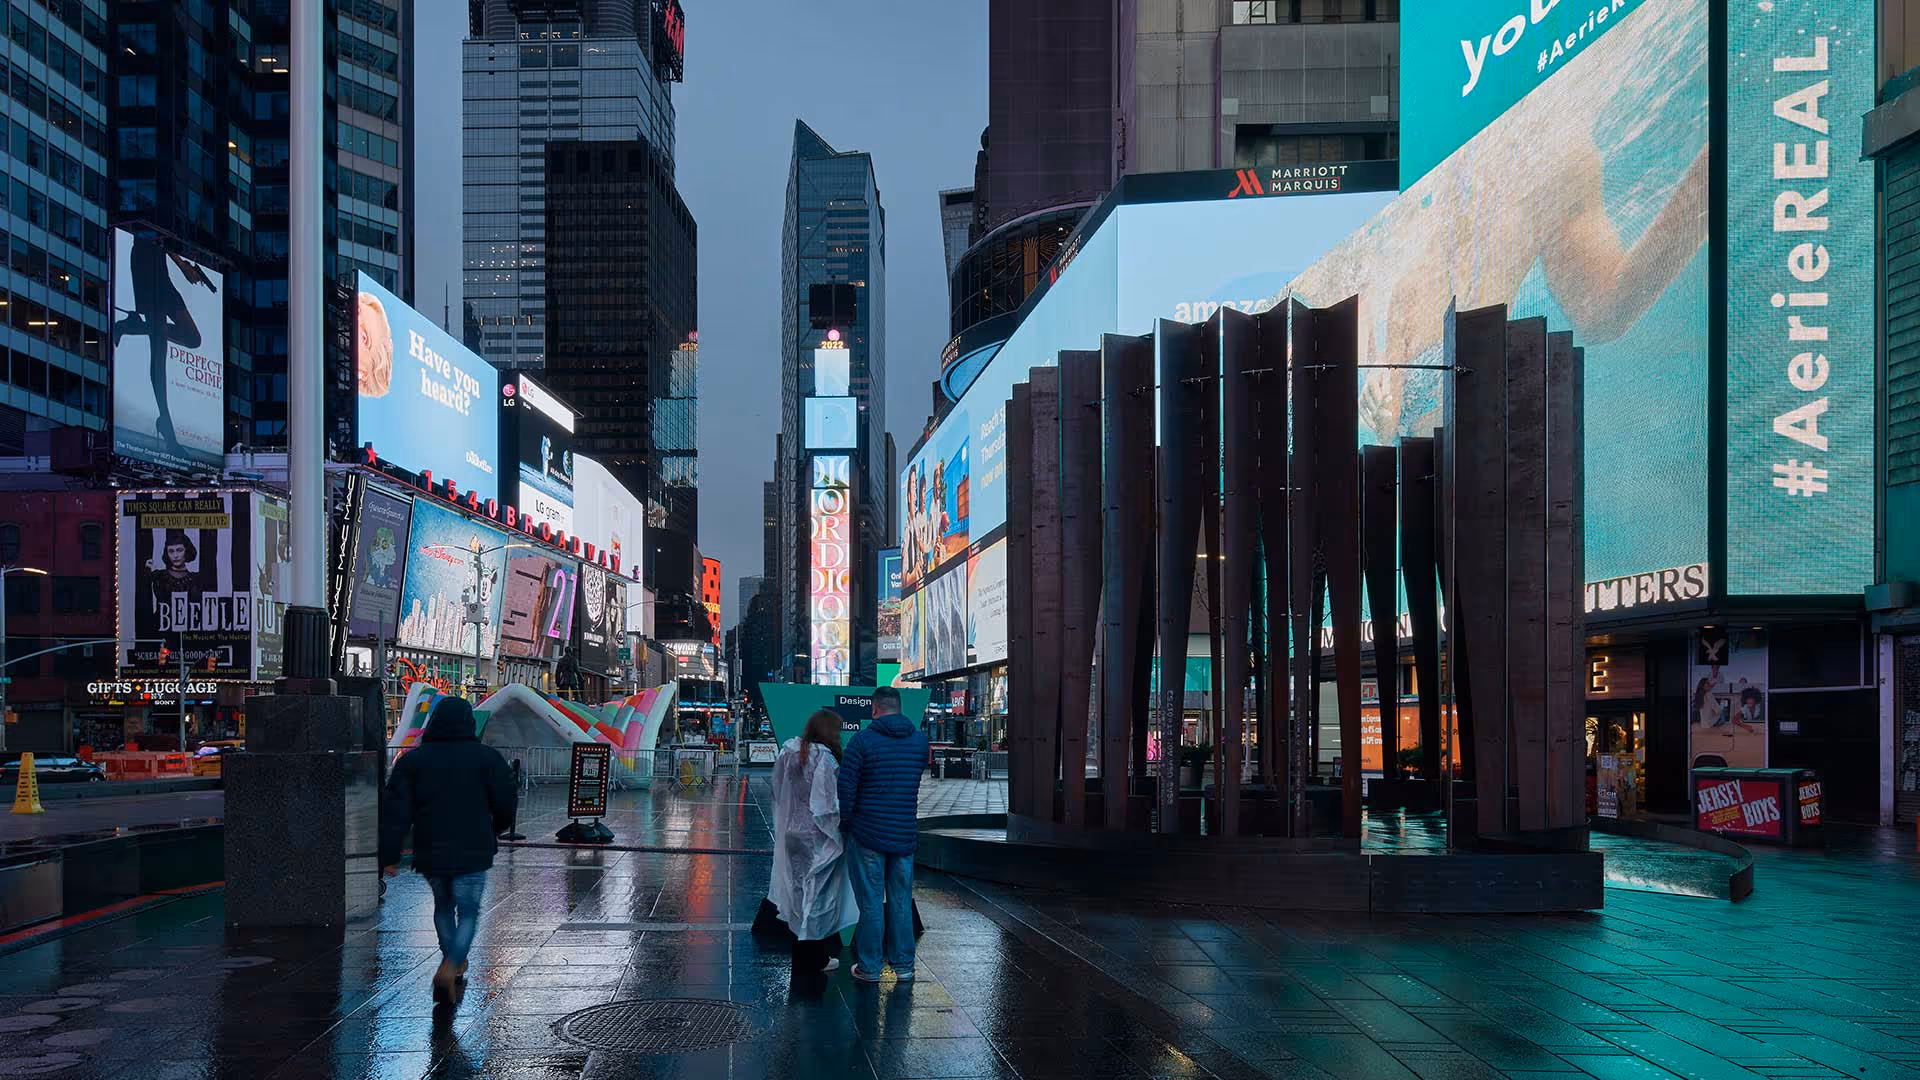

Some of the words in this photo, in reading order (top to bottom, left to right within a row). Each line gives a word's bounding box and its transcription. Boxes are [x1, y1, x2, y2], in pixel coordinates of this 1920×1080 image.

[1461, 0, 1560, 97] you
[1272, 166, 1348, 179] MARRIOTT
[1272, 180, 1338, 192] MARQUIS
[1773, 36, 1829, 497] #AerieREAL
[821, 341, 845, 350] 2022
[170, 346, 223, 376] PERFECT
[409, 329, 451, 380] Have
[453, 367, 481, 400] you
[185, 367, 223, 389] CRIME
[421, 368, 471, 417] heard?
[503, 399, 515, 407] LG
[126, 502, 147, 512] TIMES
[148, 501, 176, 513] SQUARE
[178, 500, 193, 511] CAN
[194, 499, 222, 511] REALLY
[421, 470, 498, 520] 1540
[143, 516, 165, 526] MAKE
[167, 516, 181, 526] YOU
[184, 516, 201, 526] FEEL
[500, 504, 622, 575] BROADWAY
[1585, 564, 1705, 611] TTERS
[158, 596, 251, 632] BEETLE
[547, 568, 579, 642] 21
[87, 682, 132, 694] GIFTS
[497, 661, 544, 690] OREVER
[839, 696, 873, 708] Design
[840, 721, 860, 730] lion
[1698, 779, 1744, 814] JERSEY
[1798, 782, 1822, 801] JERSEY
[1741, 796, 1781, 828] BOYS
[1801, 803, 1821, 820] BOYS
